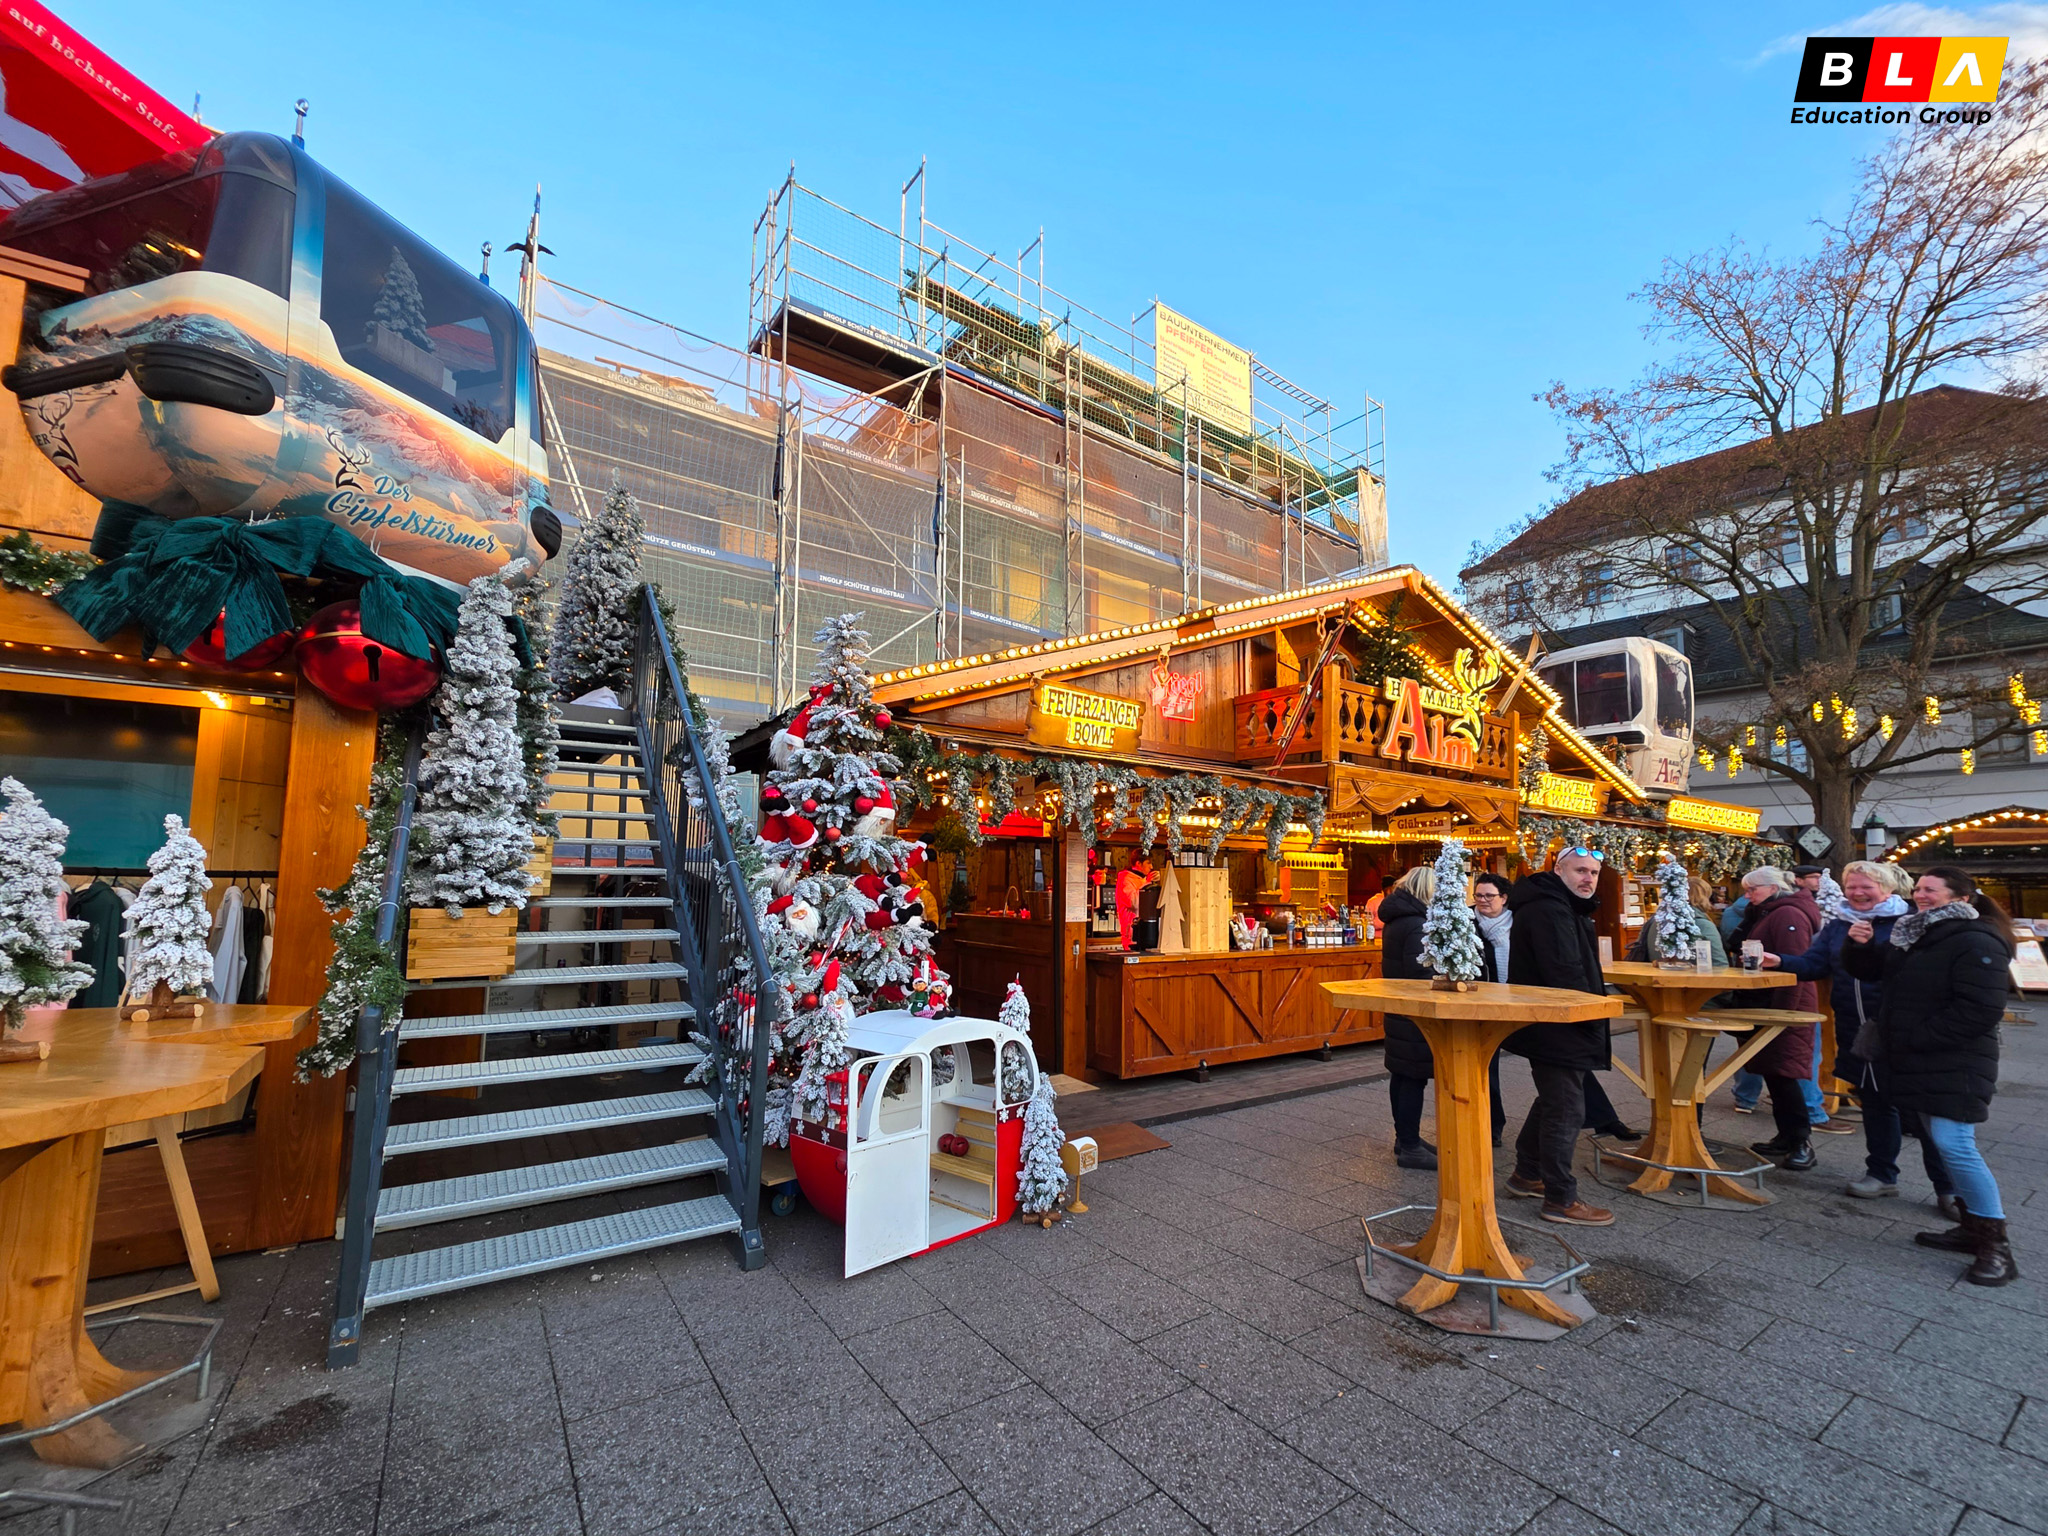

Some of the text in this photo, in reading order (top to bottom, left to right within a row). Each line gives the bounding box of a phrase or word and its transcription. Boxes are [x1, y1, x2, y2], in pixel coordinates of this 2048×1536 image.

[9, 7, 47, 37] auf
[50, 35, 132, 103] höchster
[1159, 310, 1247, 366] BAUUNTERNEHMEN
[1165, 325, 1214, 358] PFEIFFER
[822, 441, 846, 454] INGOLF
[373, 475, 413, 503] Der
[327, 490, 499, 555] Gipfelstürmer
[643, 533, 717, 557] HÜTZE GERÜSTBAU
[819, 574, 843, 585] INGOLF
[1045, 687, 1141, 728] FEUERZANGEN
[1072, 720, 1117, 747] BOWLE
[1382, 676, 1475, 772] Alm
[1542, 772, 1596, 799] ÜHWEIN
[1324, 810, 1369, 820] uerzangen-
[1550, 792, 1599, 814] WINZER
[1397, 816, 1444, 830] Glühwein
